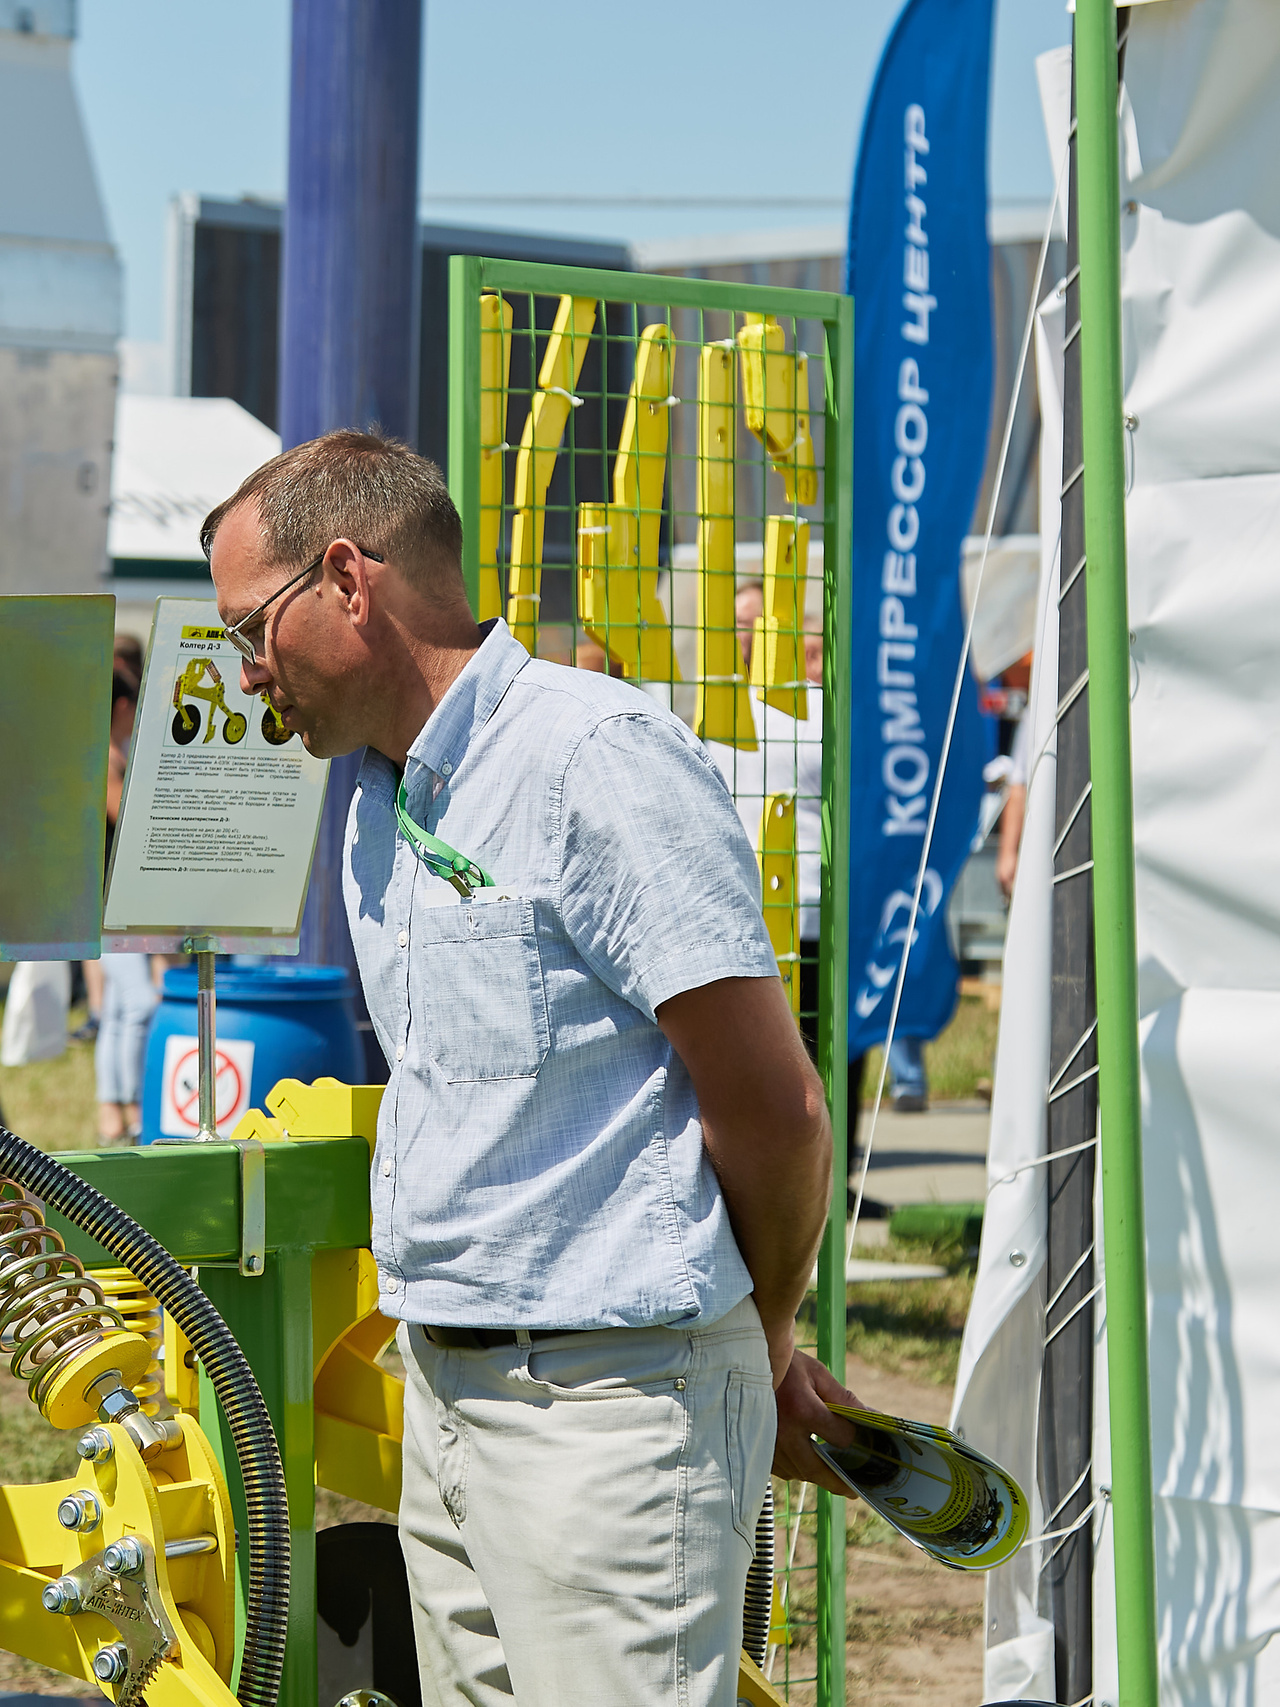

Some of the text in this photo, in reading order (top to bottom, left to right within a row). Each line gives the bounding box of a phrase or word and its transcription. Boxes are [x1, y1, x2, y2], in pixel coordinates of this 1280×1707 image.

[877, 103, 938, 836] КОМПРЕССОР ЦЕНТР
[180, 641, 221, 650] Колтер Д-3
[87, 1596, 146, 1622] АПК-ИНТЕХ
